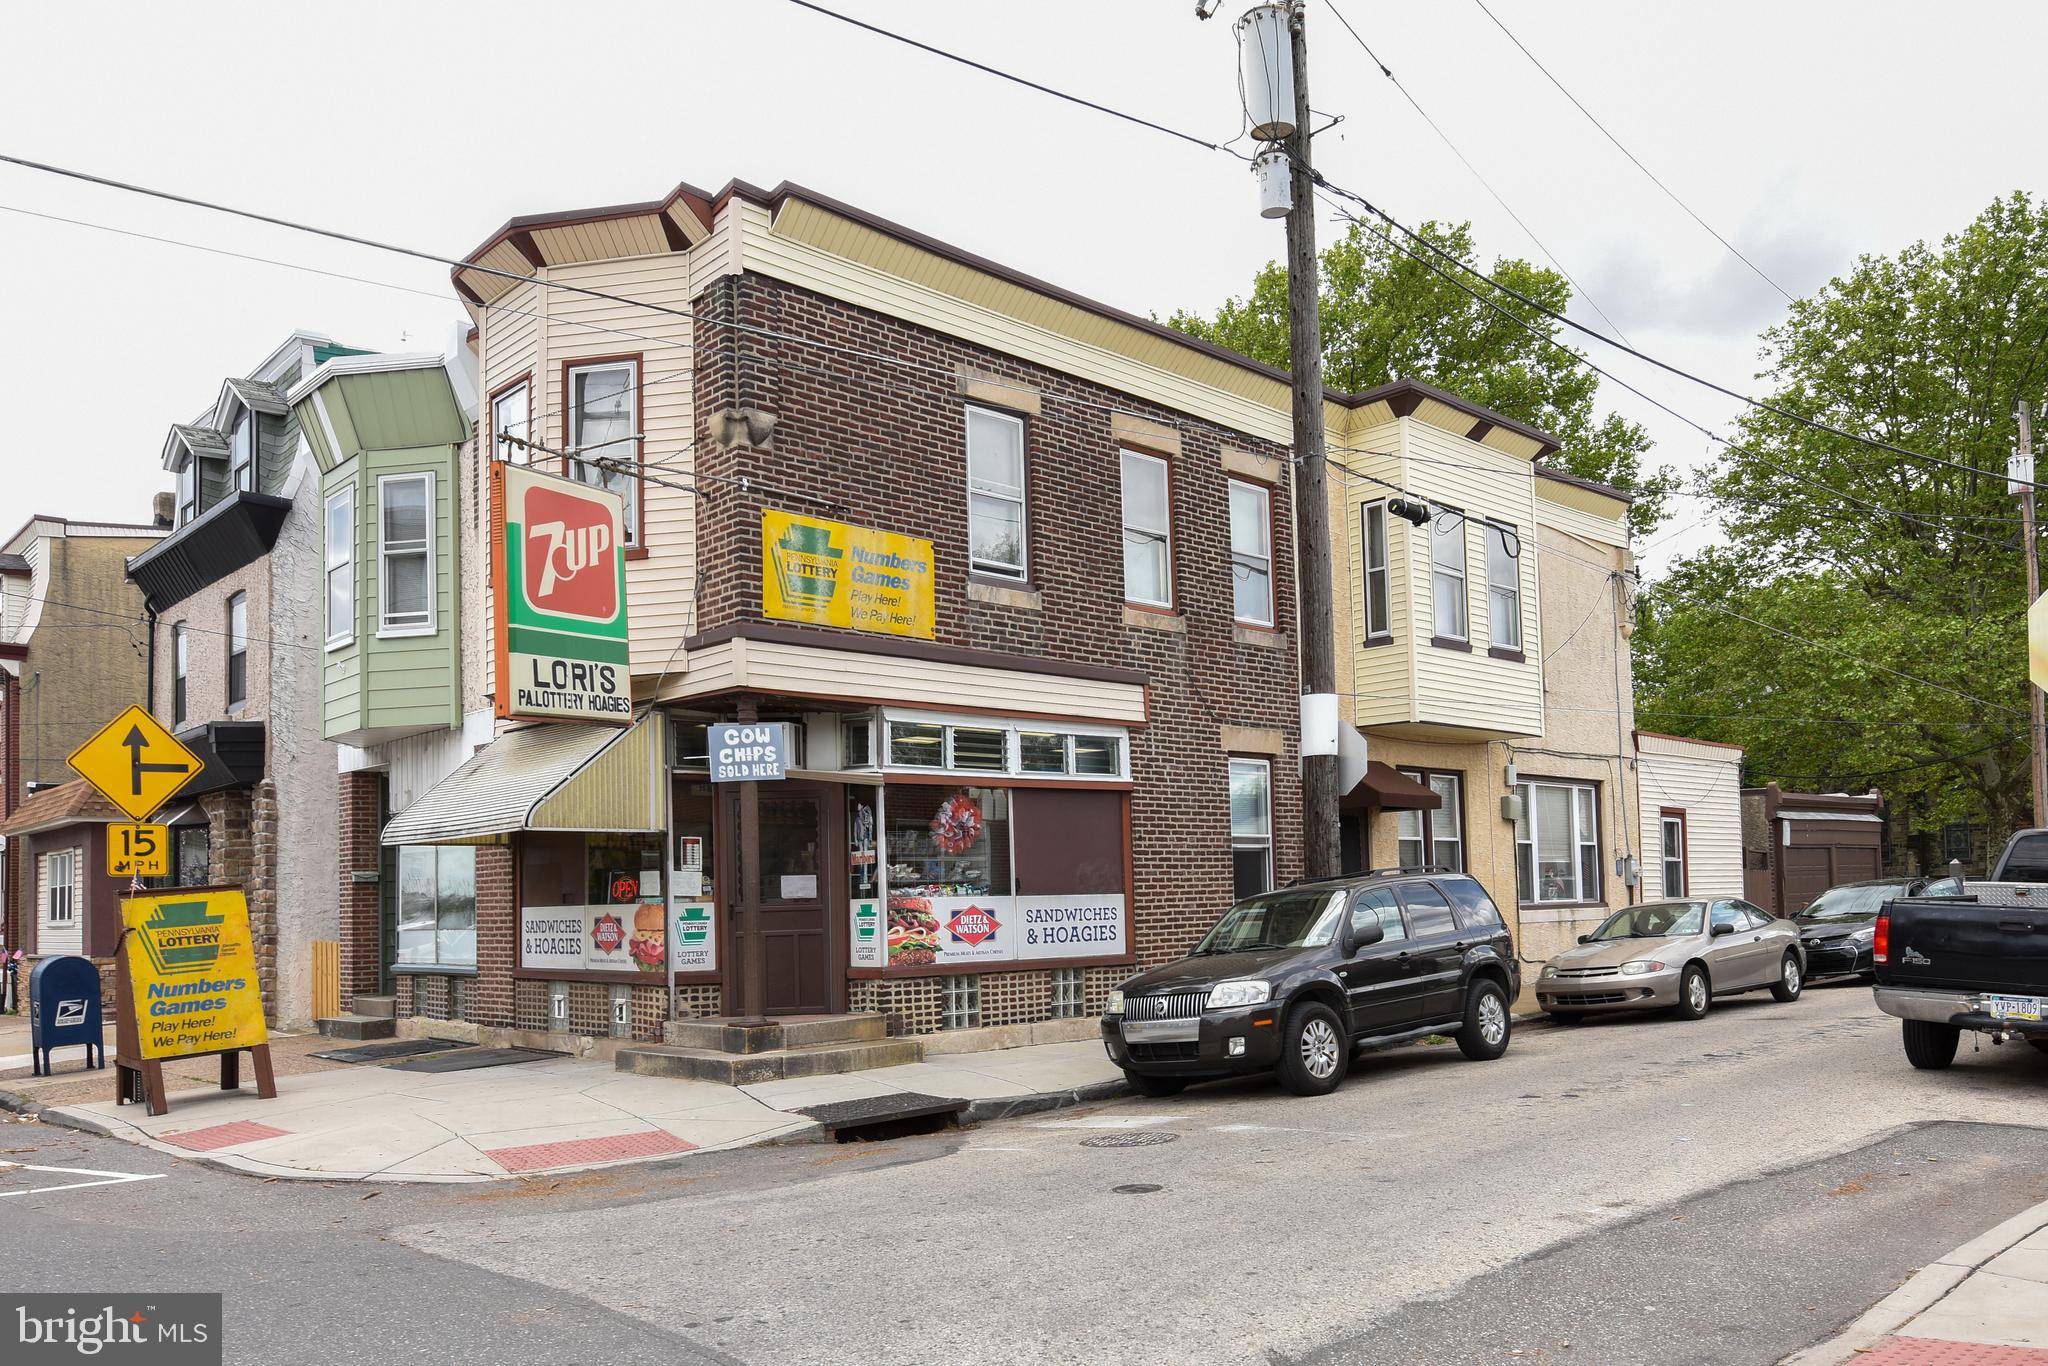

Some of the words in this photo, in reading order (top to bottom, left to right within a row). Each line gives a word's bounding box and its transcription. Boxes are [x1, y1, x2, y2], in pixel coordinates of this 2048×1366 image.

[528, 520, 610, 598] 7UP
[786, 552, 839, 567] PENNSYLVANIA
[850, 545, 928, 574] Numbers
[786, 561, 839, 579] LOTTERY
[851, 566, 911, 591] Games
[850, 589, 874, 603] Play
[874, 594, 901, 608] Here!
[850, 607, 868, 619] We
[868, 610, 889, 625] Pay
[889, 611, 916, 627] Here!
[532, 658, 616, 695] LORI'S
[588, 694, 630, 714] HOAGIES
[724, 727, 770, 746] COW
[719, 745, 777, 764] CHIPS
[718, 764, 749, 778] SOLD
[752, 762, 780, 777] HERE
[121, 829, 156, 857] 15
[118, 860, 159, 870] MPH
[611, 879, 639, 898] OPEN
[1025, 906, 1118, 924] SANDWICHES
[156, 925, 220, 938] PENNSYLVANIA
[525, 919, 582, 934] SANDWICHES
[955, 923, 990, 934] WATSON
[1026, 928, 1039, 945] &
[1042, 924, 1117, 944] HOAGIES
[158, 933, 220, 948] LOTTERY
[525, 938, 533, 954] &
[534, 937, 582, 955] HOAGIES
[677, 950, 709, 958] LOTTERY
[855, 946, 877, 954] LOTTERY
[857, 953, 875, 961] GAMES
[680, 957, 706, 965] GAMES
[1902, 957, 1931, 965] F150
[147, 978, 246, 999] Numbers
[149, 997, 227, 1017] Games
[151, 1021, 180, 1033] Play
[181, 1015, 216, 1030] Here!
[153, 1036, 174, 1048] We
[176, 1034, 201, 1046] Pay
[203, 1028, 237, 1041] Here!
